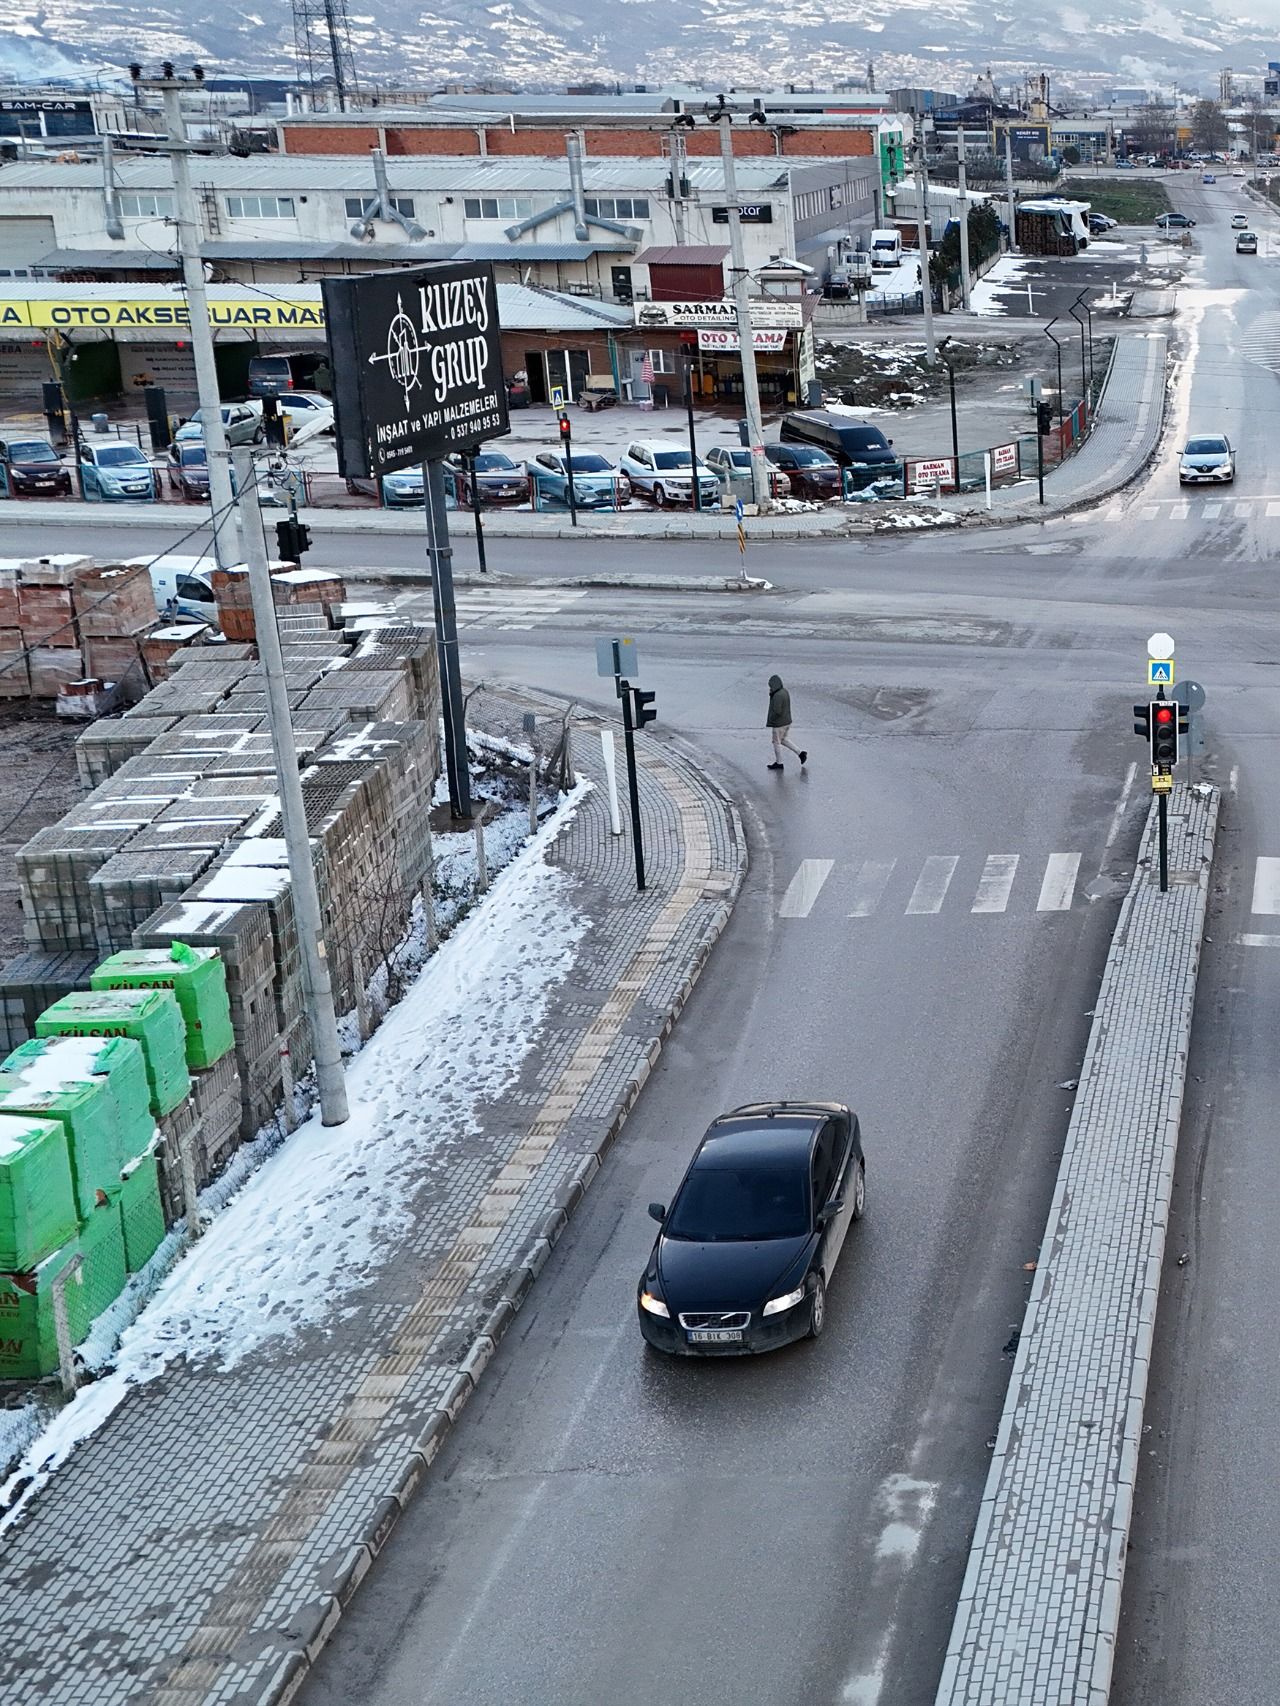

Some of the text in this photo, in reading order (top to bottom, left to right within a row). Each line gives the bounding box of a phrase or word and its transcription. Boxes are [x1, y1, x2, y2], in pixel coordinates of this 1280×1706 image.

[1, 102, 77, 110] SAM-CAR
[51, 307, 111, 324] OTO
[418, 276, 489, 334] KUZEY
[673, 304, 737, 315] SARMAN
[701, 333, 784, 343] OTO YAMA
[431, 335, 489, 403] GRUP
[376, 390, 498, 444] İNŞAAT ve YAPI MALZEMELERİ
[456, 423, 468, 438] 537
[469, 421, 482, 433] 940
[482, 418, 491, 429] 95
[492, 413, 500, 426] 53
